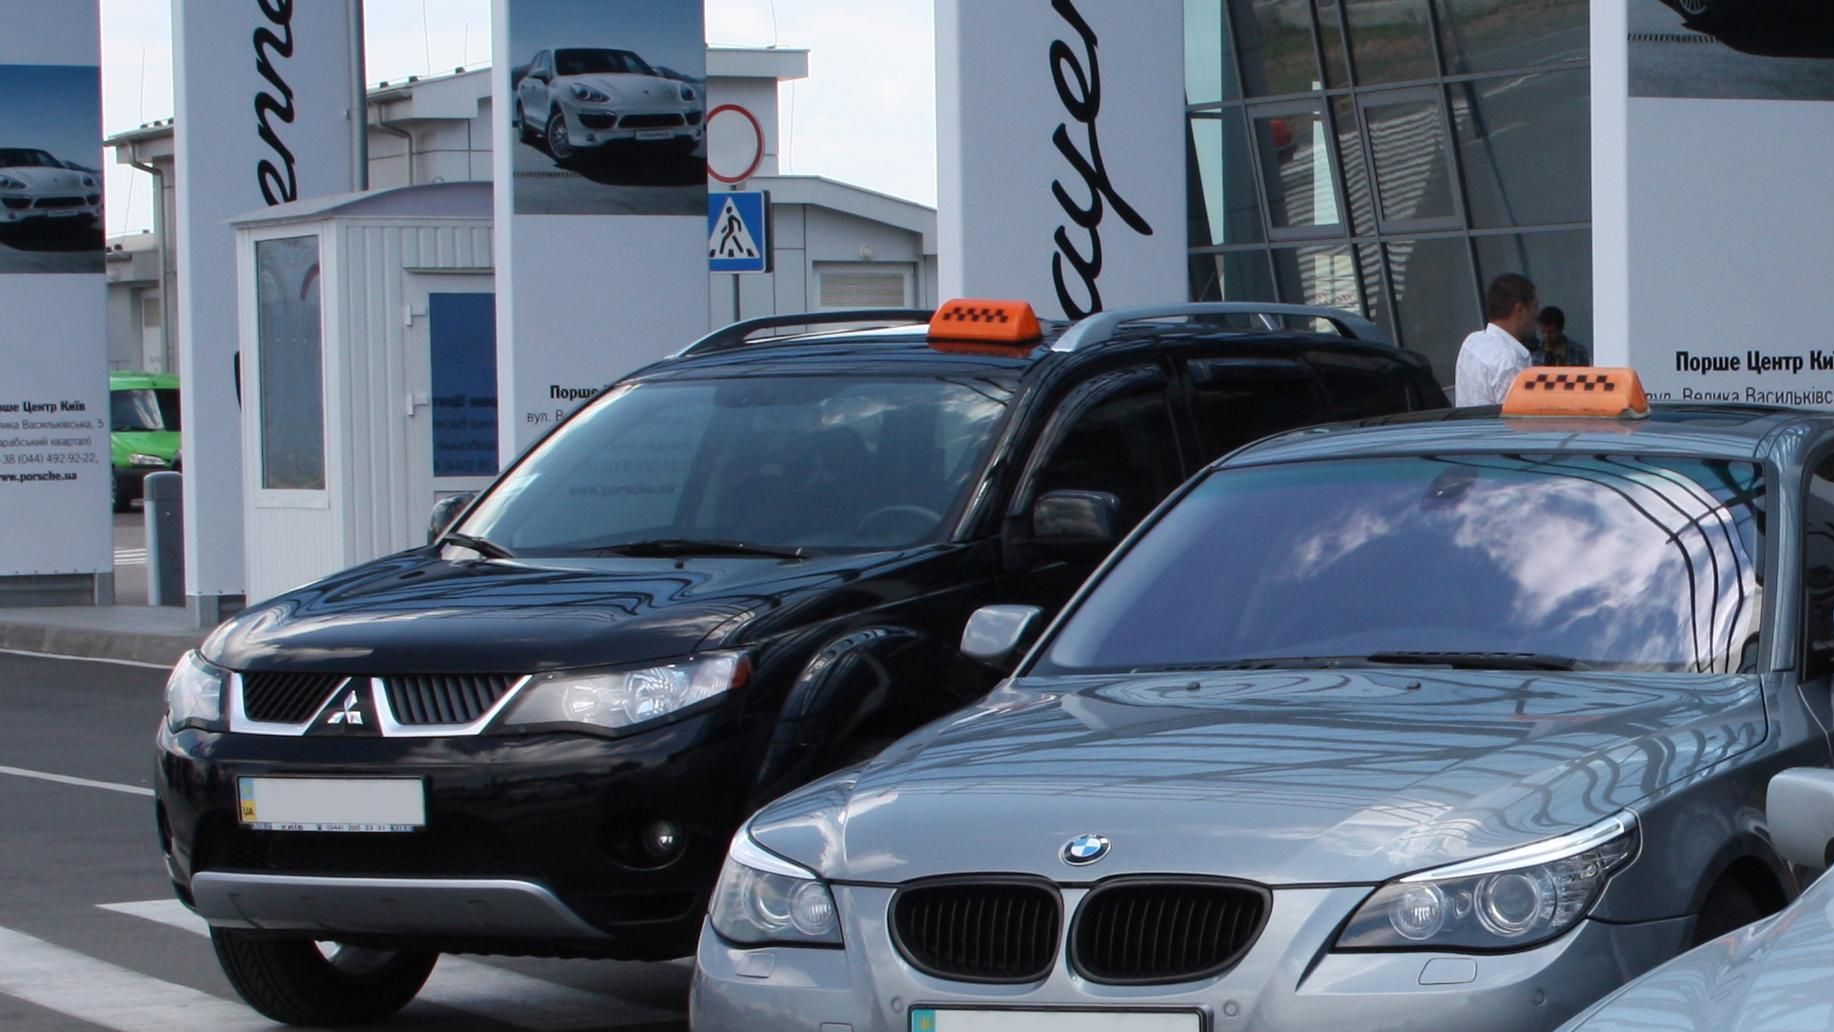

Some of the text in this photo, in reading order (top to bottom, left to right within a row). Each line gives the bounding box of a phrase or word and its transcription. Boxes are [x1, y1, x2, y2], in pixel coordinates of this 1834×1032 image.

[1676, 351, 1740, 374] Порше
[1747, 350, 1803, 374] Центр
[23, 401, 57, 414] Центр
[60, 401, 86, 411] Київ
